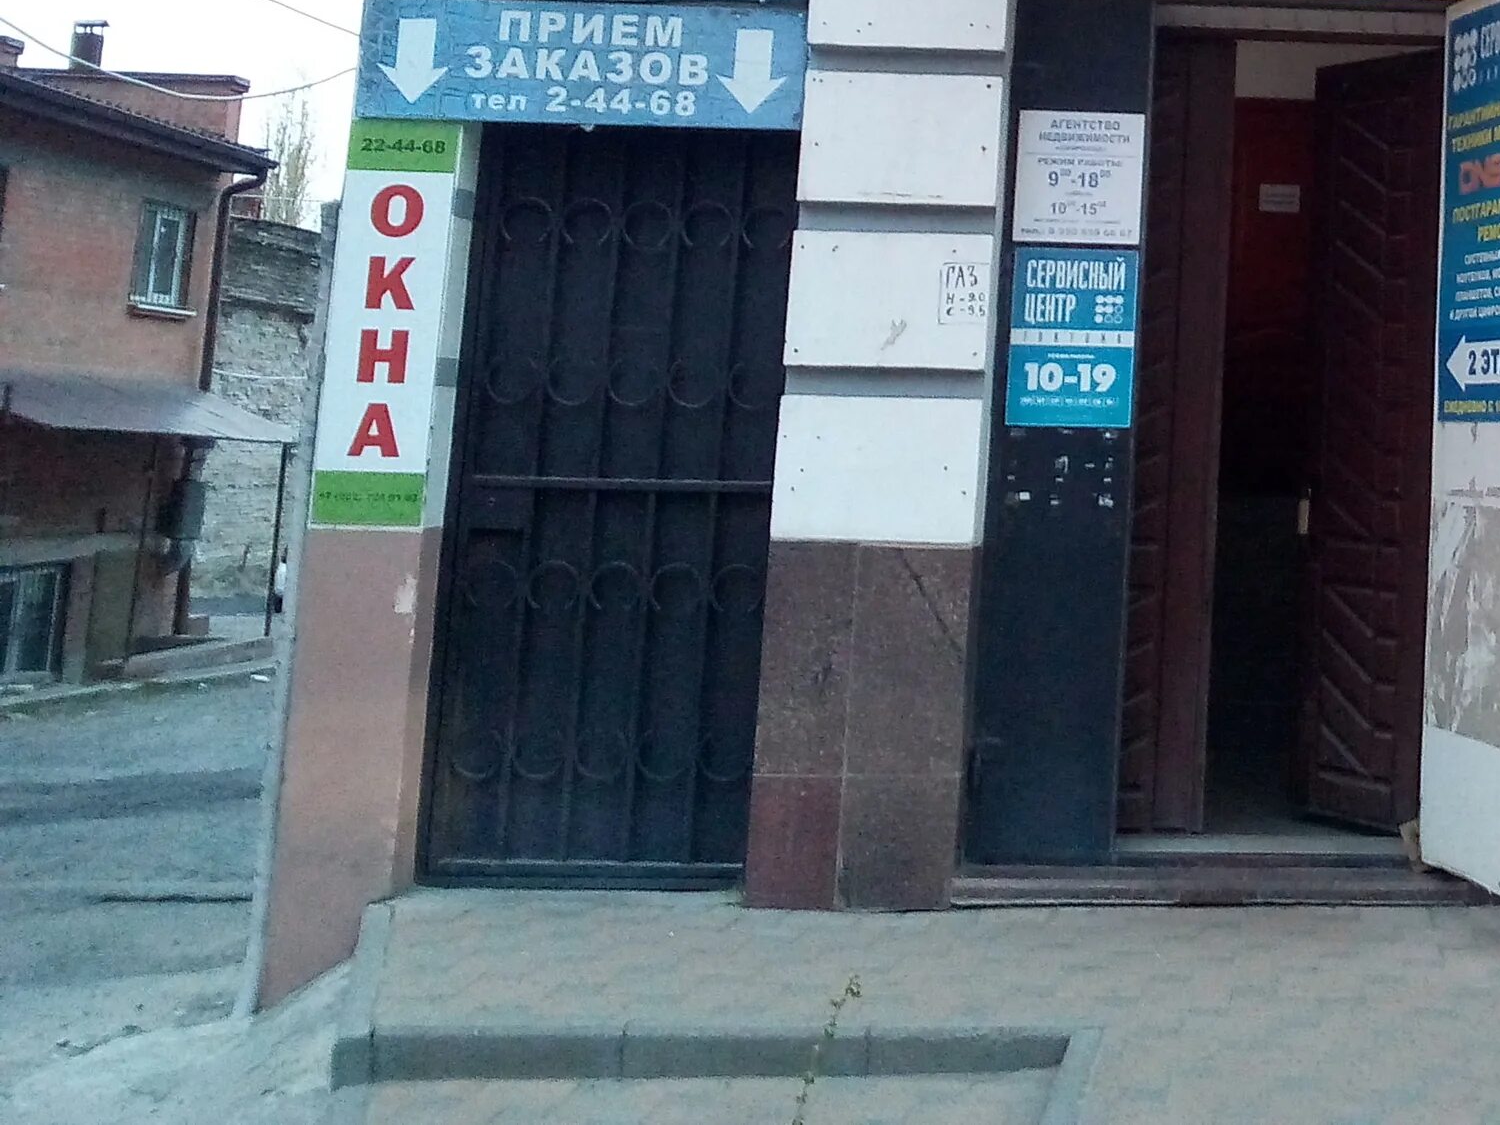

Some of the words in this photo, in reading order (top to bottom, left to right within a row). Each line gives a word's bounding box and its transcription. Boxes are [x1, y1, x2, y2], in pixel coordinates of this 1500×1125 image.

[499, 9, 684, 48] ПРИЕМ
[464, 46, 709, 86] ЗАКАЗОВ
[471, 92, 528, 112] тел
[545, 86, 697, 116] 2-44-68
[1050, 118, 1120, 131] АГЕНТСТВО
[360, 137, 446, 154] 22-44-68
[946, 265, 978, 289] ГАЗ
[1025, 257, 1126, 291] СЕРВИСНЫЙ
[347, 183, 425, 458] ОКНА
[1024, 292, 1078, 324] ЦЕНТР
[1024, 361, 1117, 393] 10-19
[1468, 349, 1477, 375] 2
